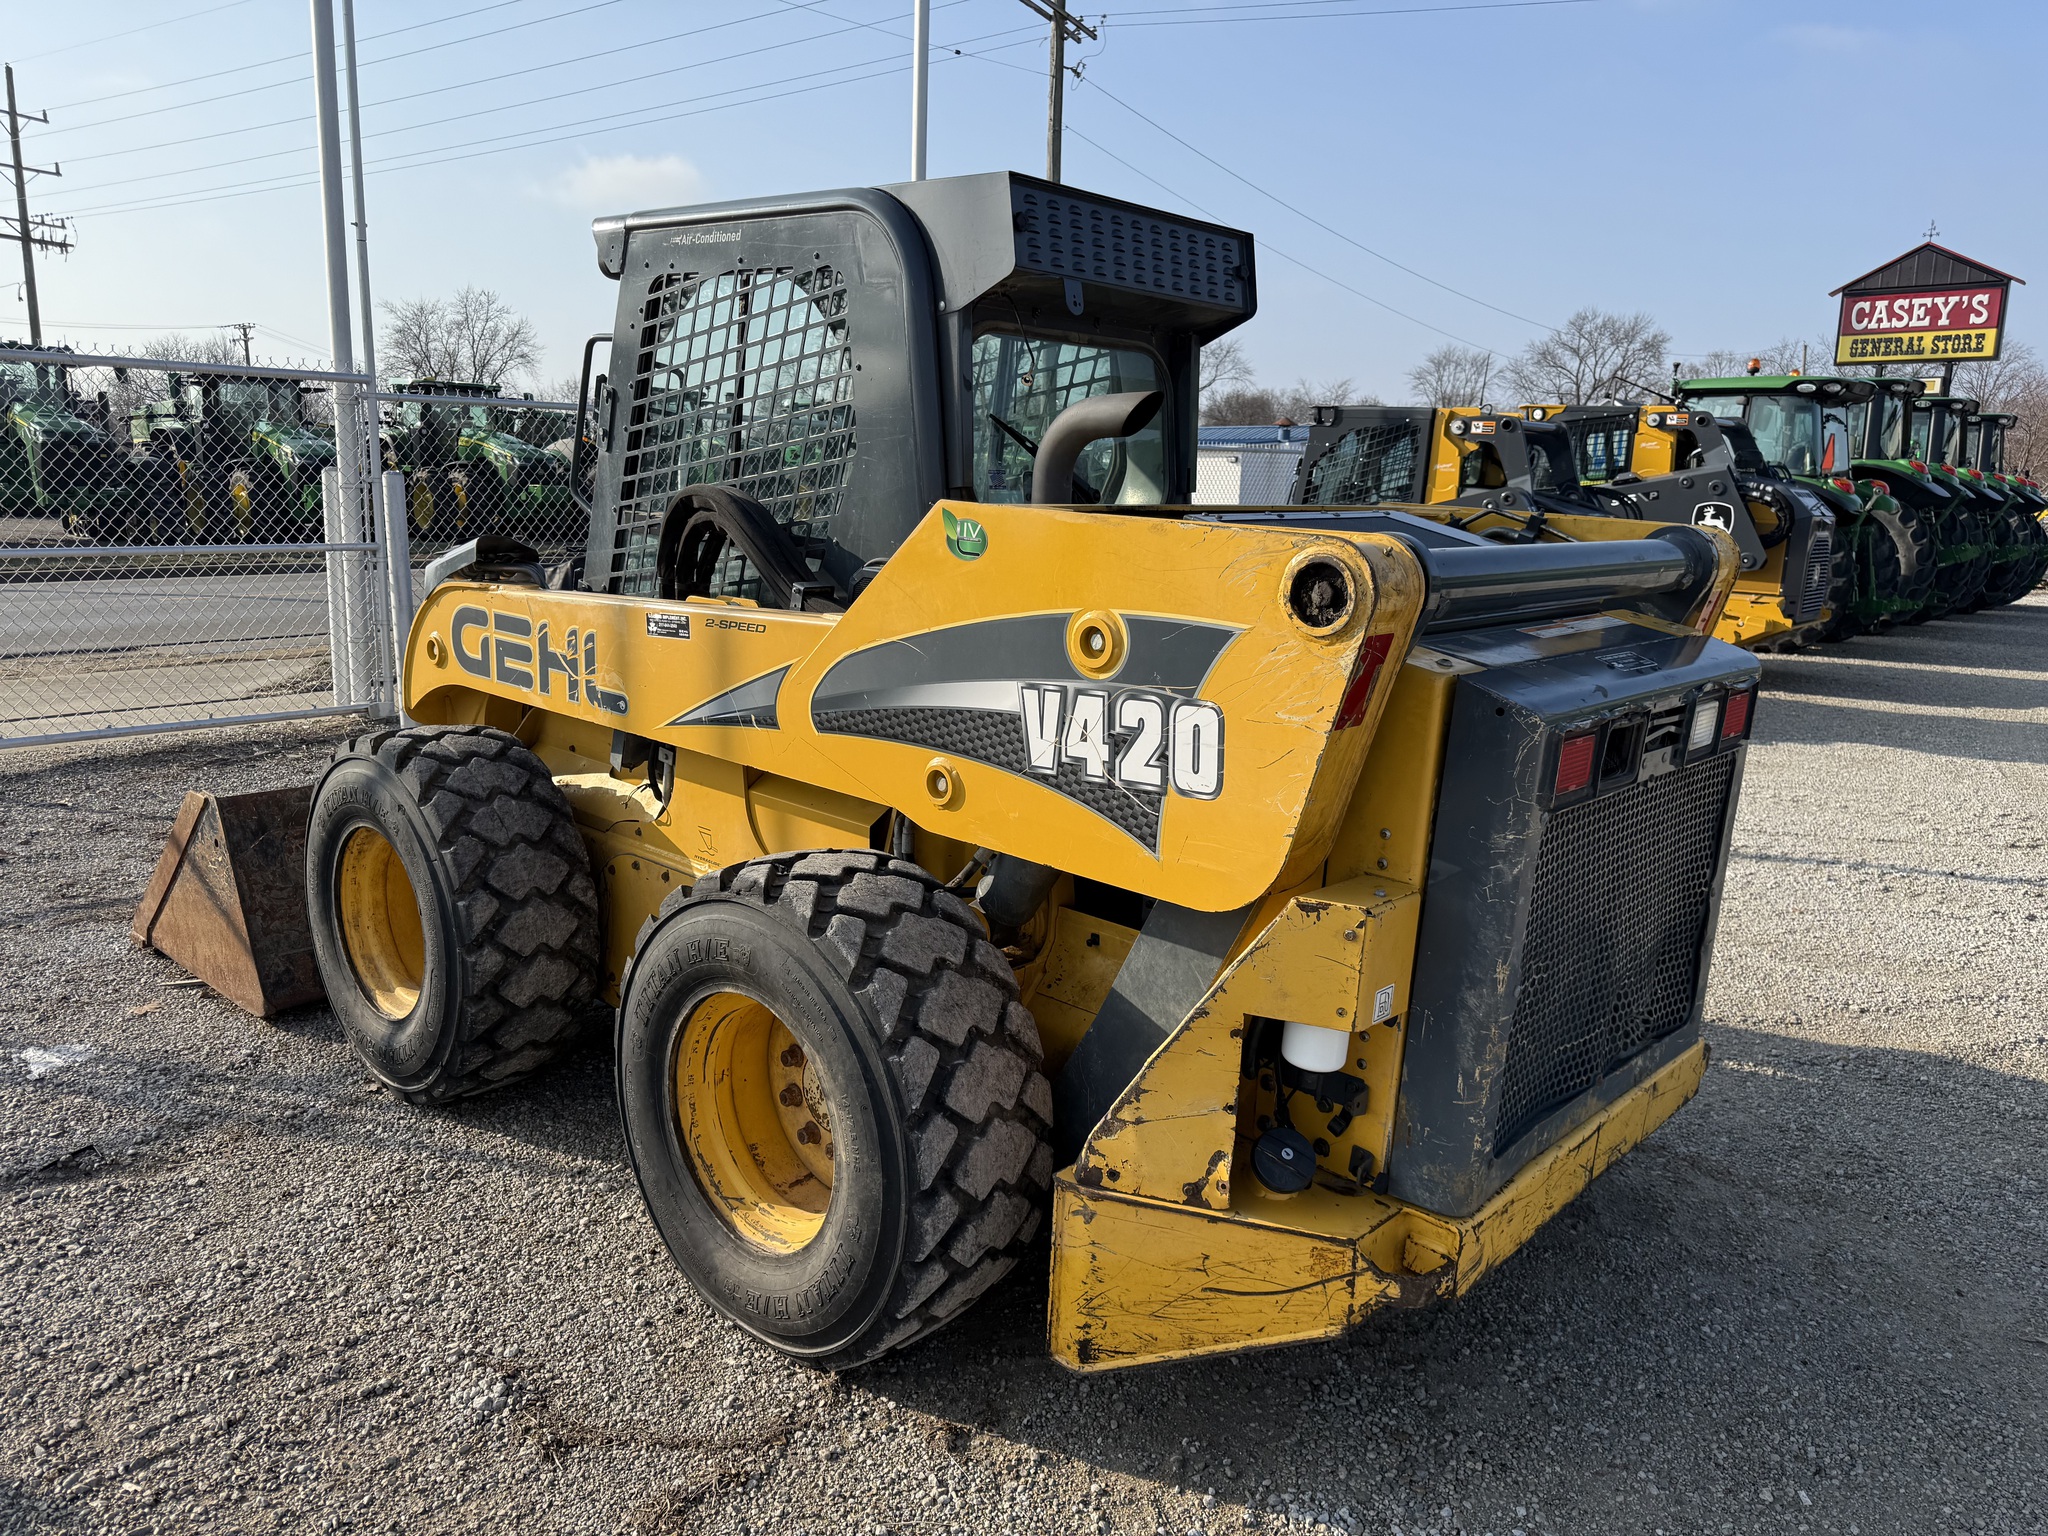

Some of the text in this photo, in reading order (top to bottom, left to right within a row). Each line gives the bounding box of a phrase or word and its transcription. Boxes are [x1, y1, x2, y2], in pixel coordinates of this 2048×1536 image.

[681, 229, 742, 245] Air-Conditioned
[1851, 293, 1990, 331] CASEY'S
[1849, 332, 1986, 358] GENERAL STORE
[704, 618, 767, 634] 2-SPEED
[451, 603, 629, 718] GEHL
[1017, 681, 1226, 801] V420
[634, 938, 730, 1027] TITAN H/E
[796, 1242, 857, 1317] TITAN
